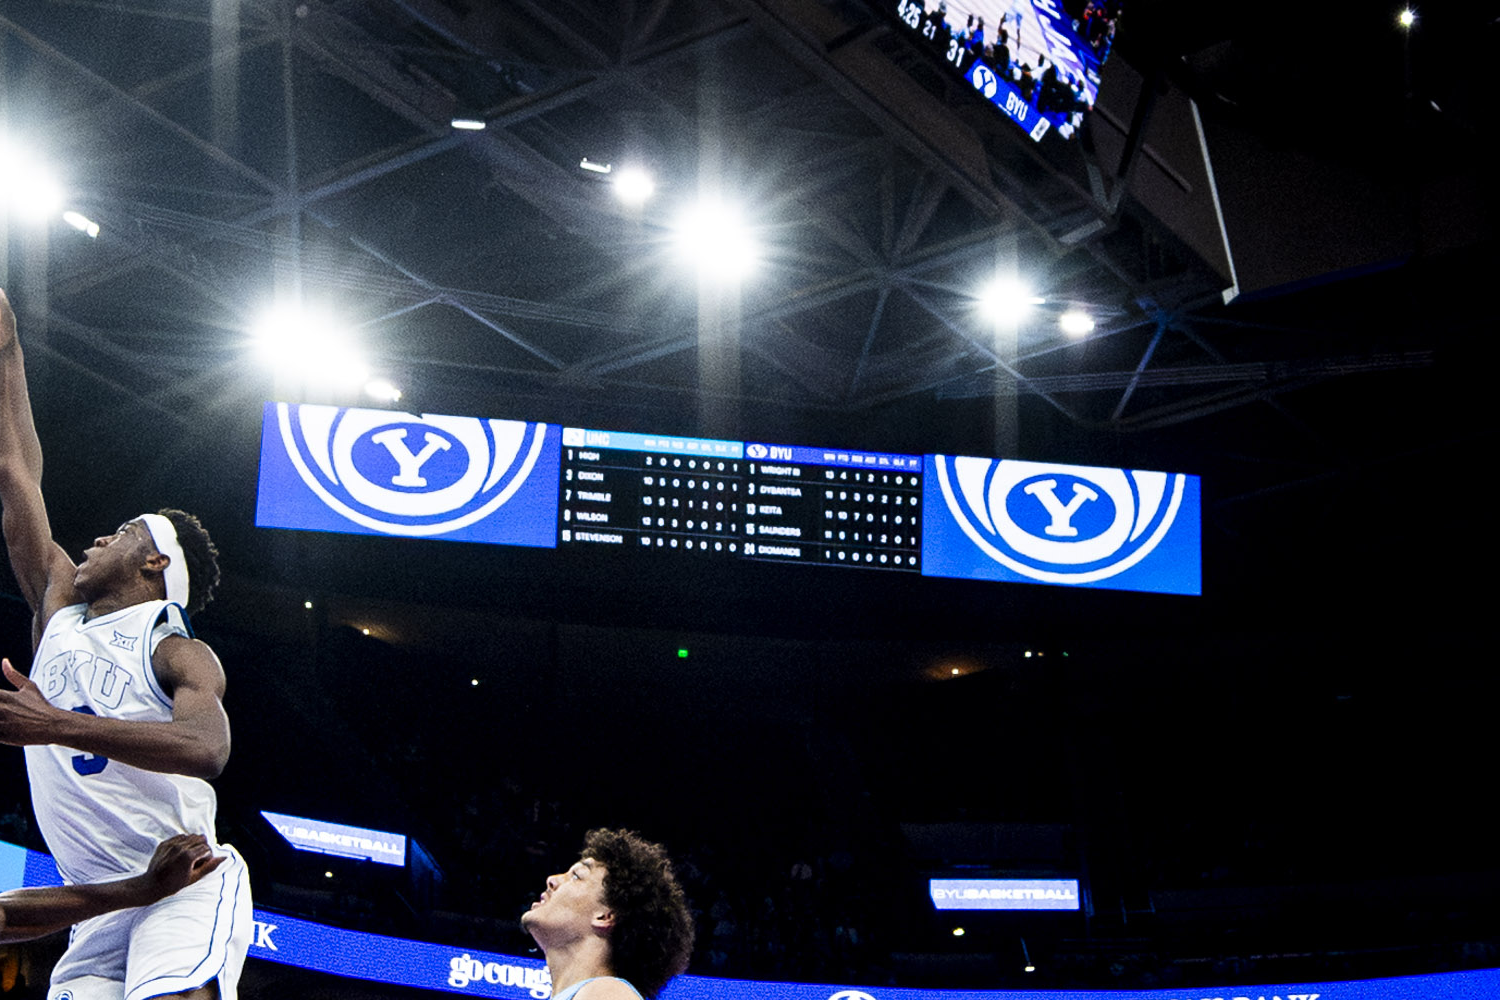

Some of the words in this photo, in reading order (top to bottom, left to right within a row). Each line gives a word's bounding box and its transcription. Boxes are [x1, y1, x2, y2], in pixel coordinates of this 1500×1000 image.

[947, 39, 965, 67] 31
[1006, 91, 1029, 121] BYU
[371, 428, 452, 487] Y
[1024, 478, 1099, 537] Y
[43, 650, 133, 710] BYU
